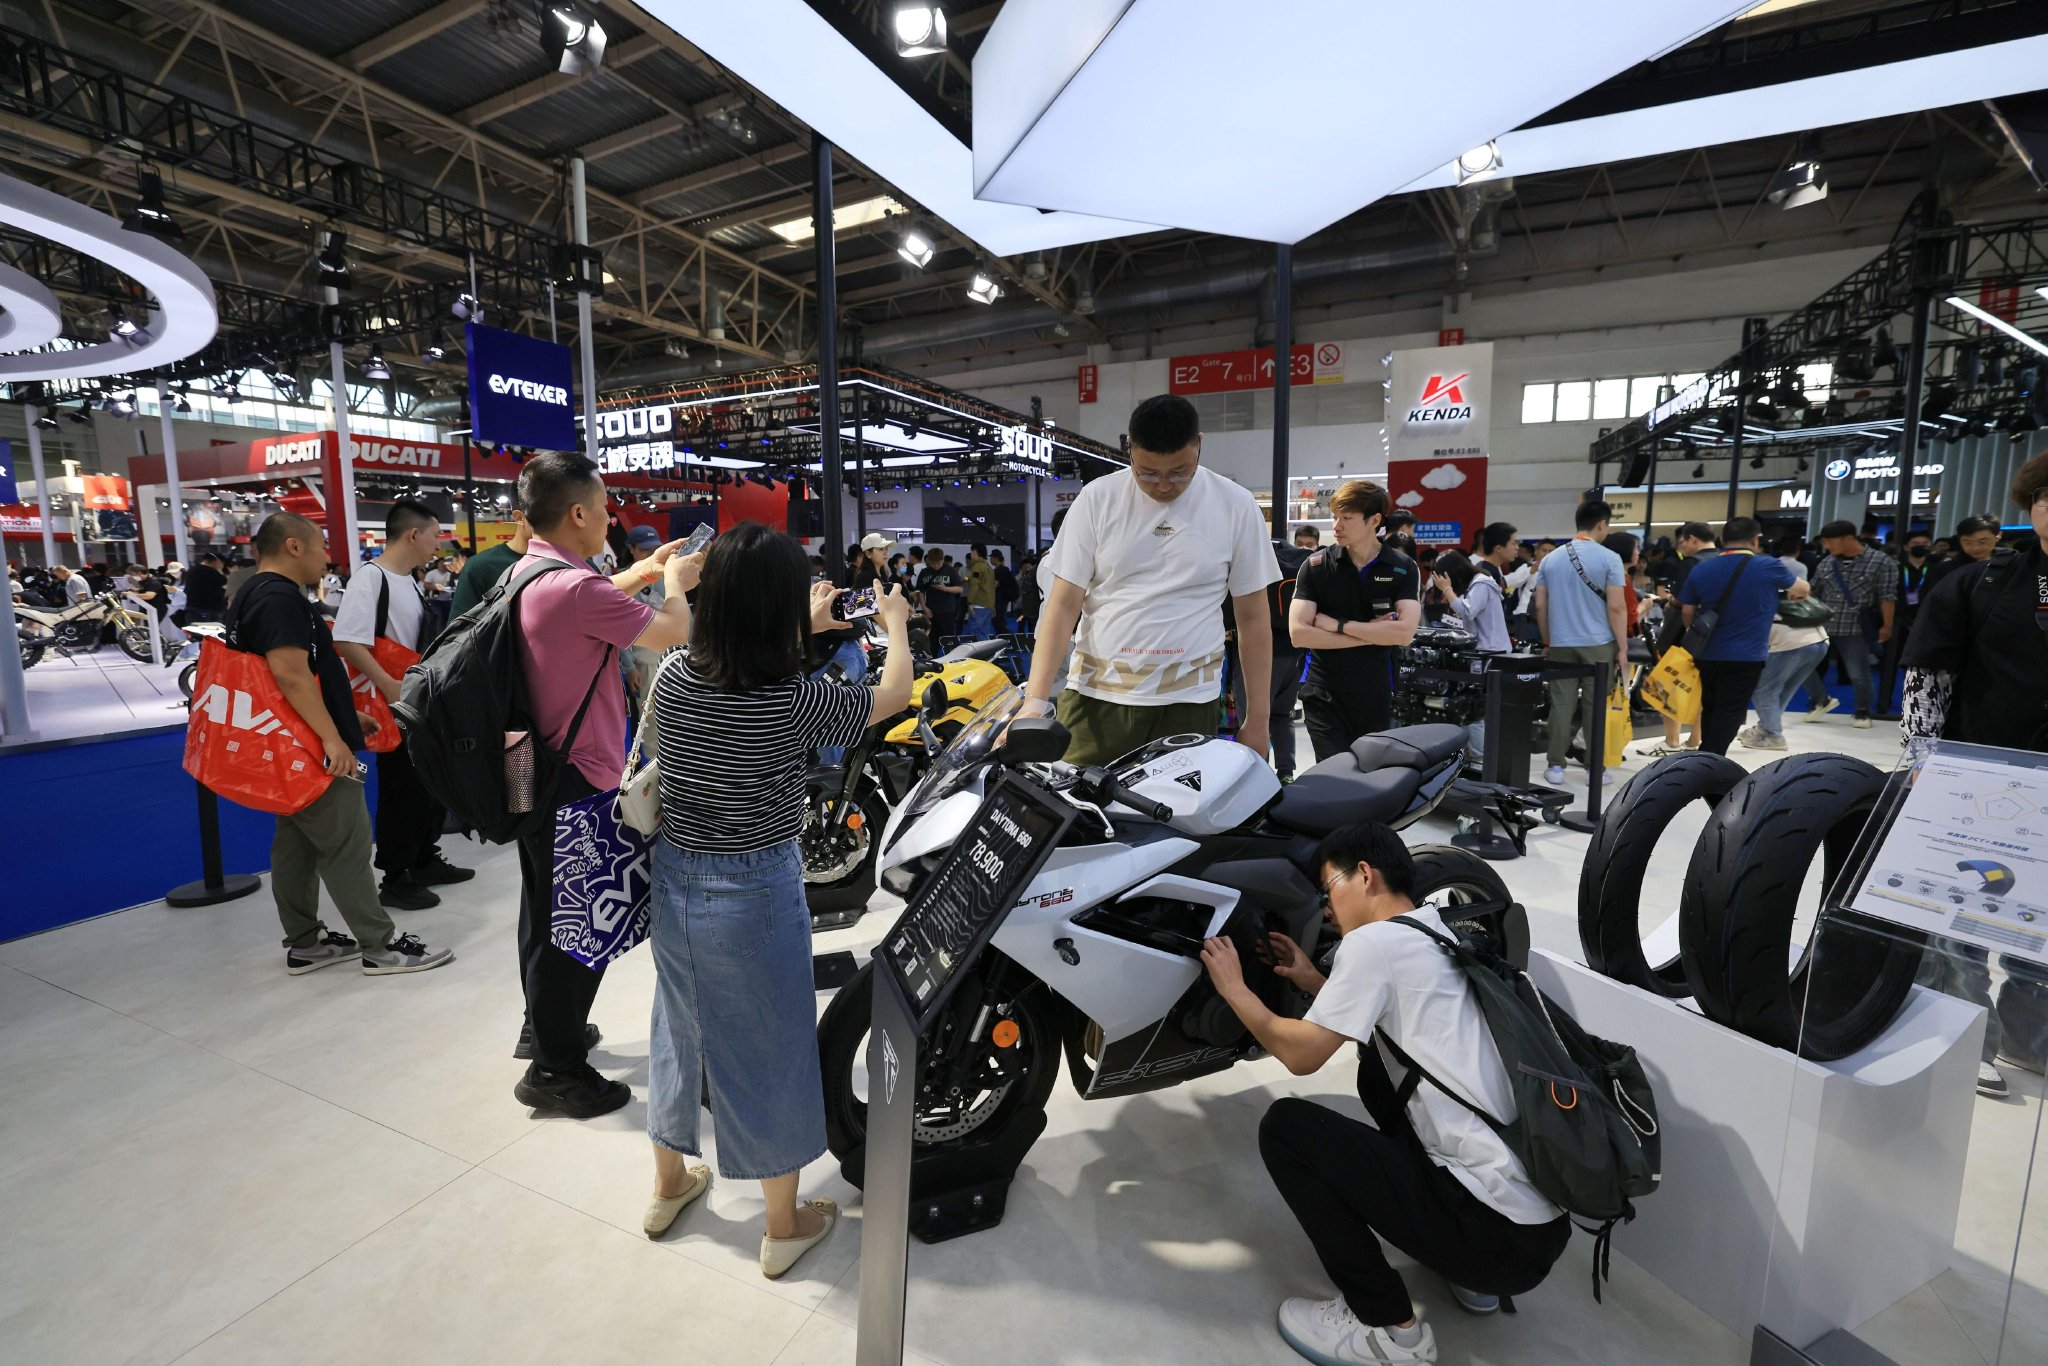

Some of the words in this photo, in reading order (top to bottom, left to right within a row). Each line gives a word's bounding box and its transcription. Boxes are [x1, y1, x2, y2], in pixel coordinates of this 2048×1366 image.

[1175, 366, 1200, 385] E2
[1202, 358, 1221, 367] Gate
[1222, 362, 1233, 380] 7
[488, 373, 568, 407] EVTEKER
[1408, 406, 1471, 422] KENDA
[265, 439, 322, 466] DUCATI
[1001, 428, 1053, 464] SOUO
[1008, 460, 1046, 477] MOTORCYCLE
[1855, 456, 1897, 469] BMW
[865, 501, 899, 510] SOUO
[2038, 574, 2048, 603] SONY
[990, 808, 1019, 839] DAYTONA
[1016, 831, 1033, 849] 660
